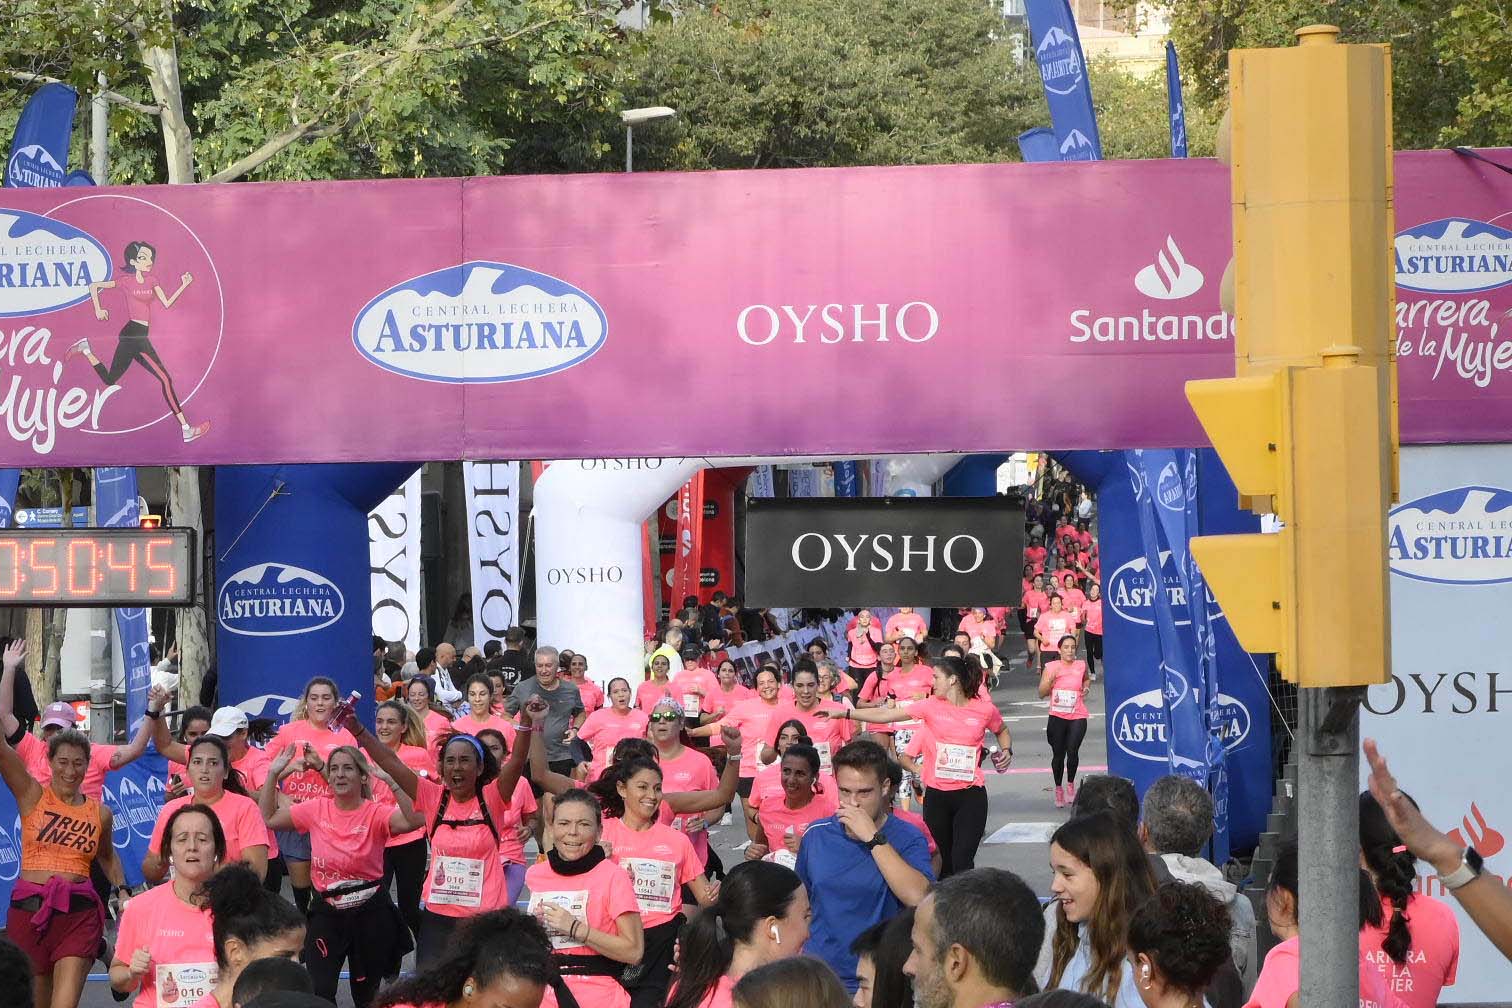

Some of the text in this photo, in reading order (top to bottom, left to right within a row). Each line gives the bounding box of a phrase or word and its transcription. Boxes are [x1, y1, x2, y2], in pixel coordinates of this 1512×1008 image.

[16, 245, 88, 256] LECHERA
[1466, 241, 1512, 251] LECHER
[1395, 248, 1512, 274] ASTURIAN
[412, 302, 579, 317] CENTRAL LECHERA
[1395, 299, 1491, 329] arrera
[373, 309, 587, 353] ASTURIANA
[736, 301, 939, 345] OYSHO
[1069, 309, 1236, 343] Santand
[1419, 328, 1436, 356] la
[1432, 326, 1512, 388] Muje
[1416, 520, 1483, 531] CENTRAL
[791, 533, 984, 574] OYSHO
[547, 565, 623, 585] OYSHO
[235, 586, 330, 596] CENTRAL LECHERA
[222, 592, 335, 620] ASTURIANA
[1361, 672, 1512, 715] OYSH
[289, 781, 330, 795] DORSAL
[57, 816, 96, 836] RUN
[51, 829, 96, 854] NERS
[446, 876, 464, 884] 016
[637, 878, 656, 887] 016
[1392, 965, 1411, 978] LA
[181, 988, 204, 997] 016
